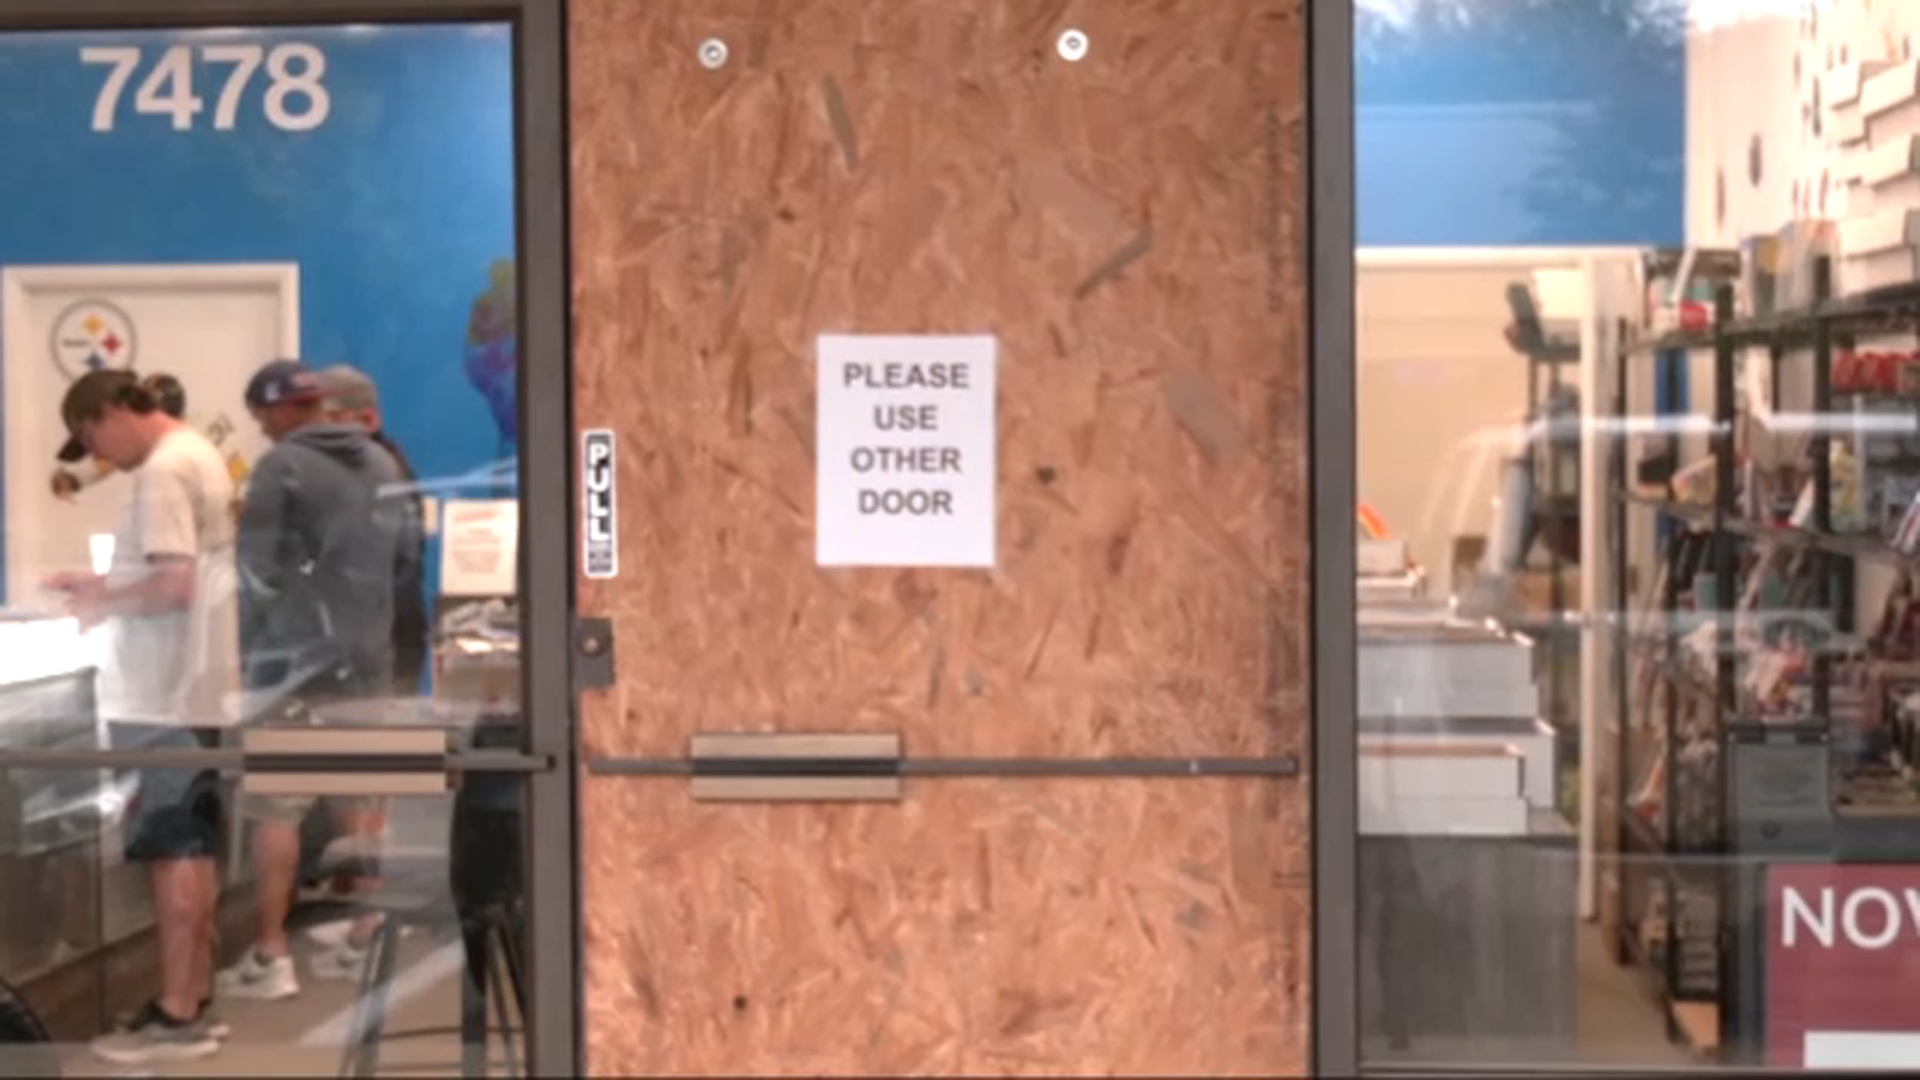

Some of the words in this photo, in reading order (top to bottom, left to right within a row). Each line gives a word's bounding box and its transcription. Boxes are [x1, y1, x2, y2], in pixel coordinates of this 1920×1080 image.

[80, 43, 330, 132] 7478
[842, 361, 970, 390] PLEASE
[873, 403, 939, 432] USE
[850, 445, 962, 474] OTHER
[587, 442, 610, 542] PULL
[858, 488, 954, 516] DOOR
[1781, 885, 1920, 949] NO
